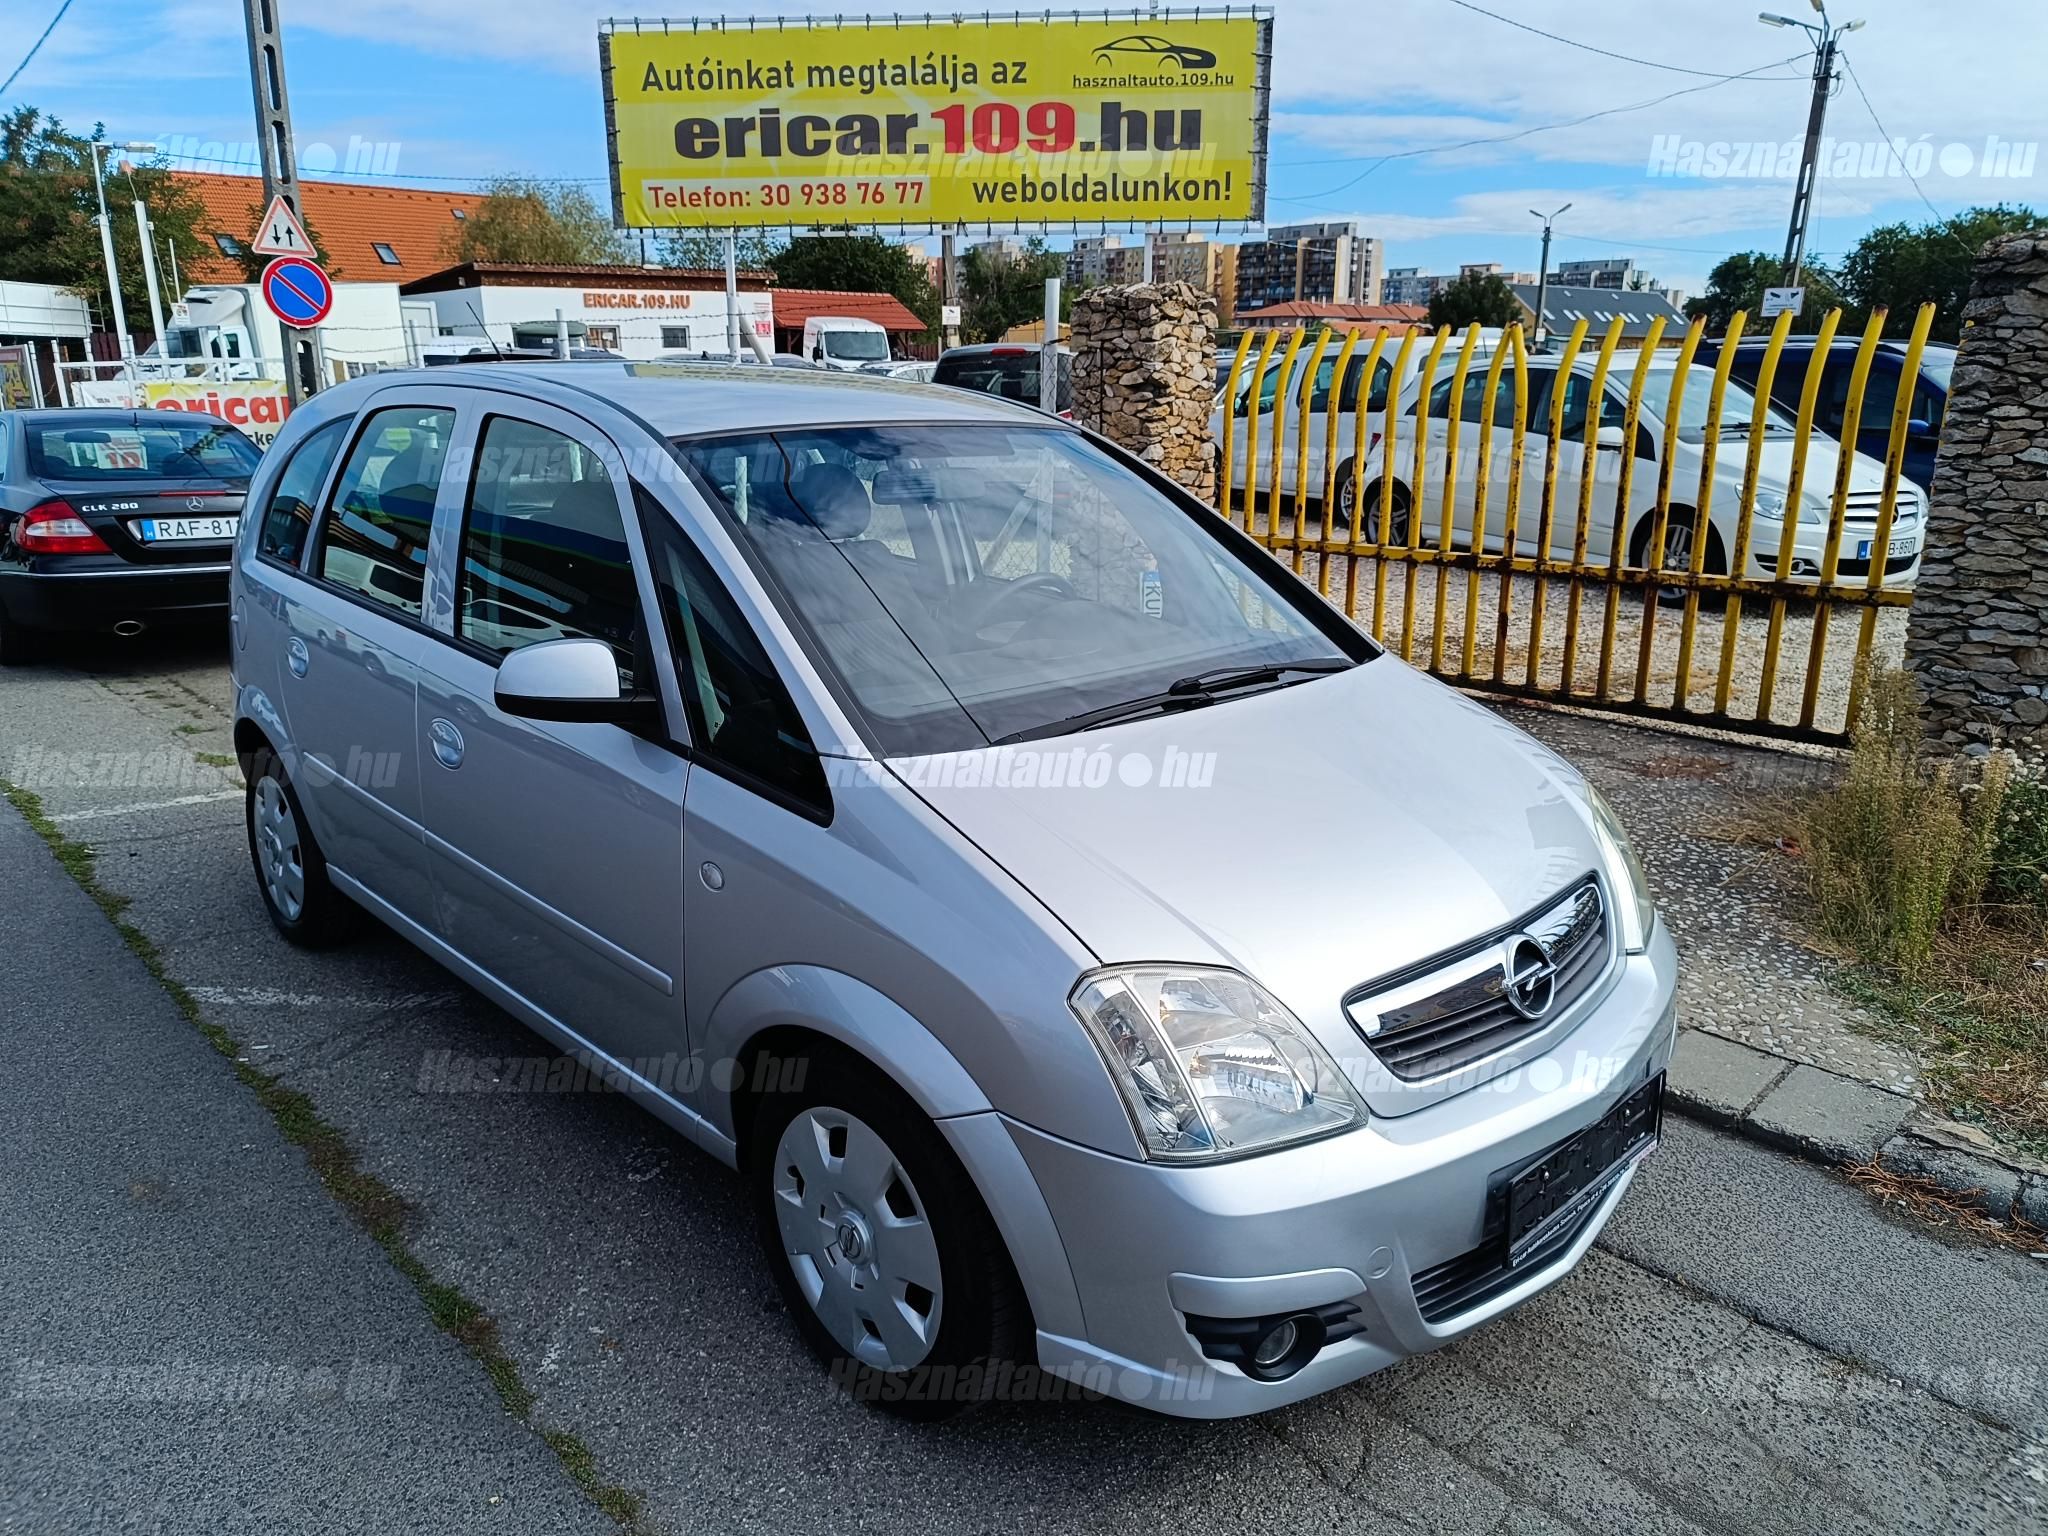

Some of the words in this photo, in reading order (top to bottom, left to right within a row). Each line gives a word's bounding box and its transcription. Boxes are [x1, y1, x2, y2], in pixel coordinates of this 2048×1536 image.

[641, 57, 794, 91] Autóinkat
[807, 52, 978, 94] megtalálja
[991, 61, 1027, 84] az
[1072, 73, 1235, 88] hasznaltauto.109.hu
[674, 101, 1202, 159] ericar.109.hu
[648, 186, 751, 208] Telefon:
[760, 184, 790, 206] 30
[799, 183, 846, 205] 938
[856, 182, 884, 204] 76
[895, 181, 923, 203] 77
[972, 171, 1231, 203] weboldalunkon!
[583, 293, 691, 309] ERICAR.109.HU
[82, 504, 107, 512] CLK
[111, 502, 139, 510] 280
[158, 518, 241, 538] RAF-81
